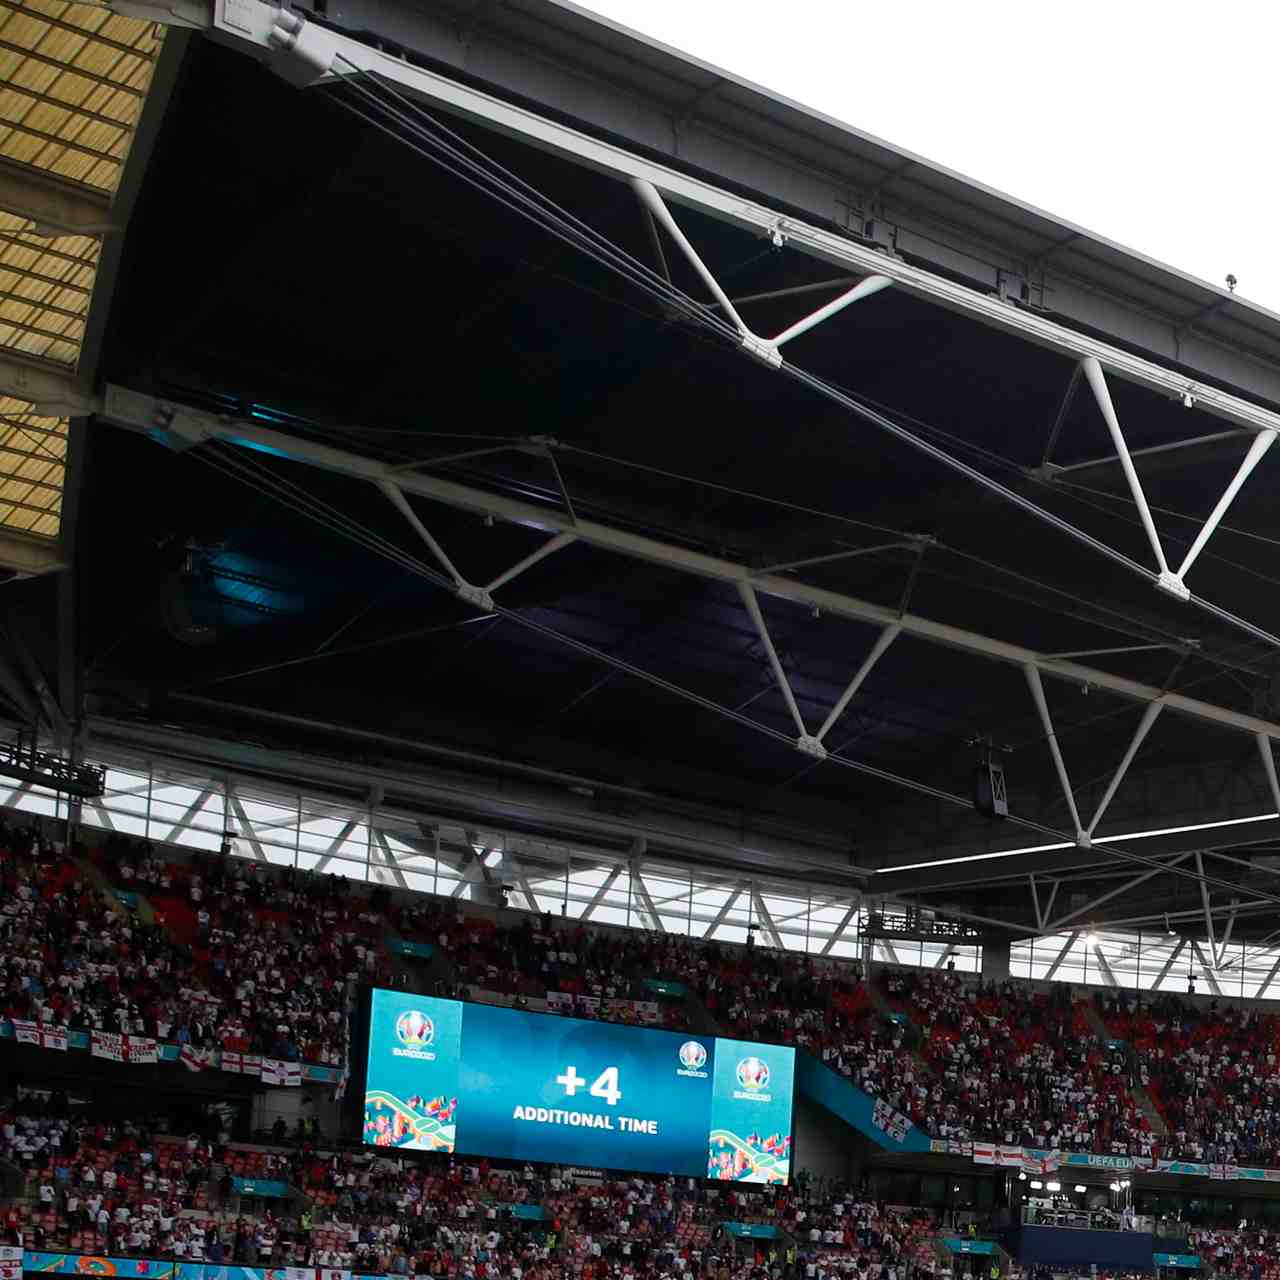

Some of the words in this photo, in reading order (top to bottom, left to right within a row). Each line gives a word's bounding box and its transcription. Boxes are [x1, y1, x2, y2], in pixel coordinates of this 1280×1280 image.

[556, 1066, 622, 1106] +4
[513, 1105, 614, 1130] ADDITIONAL
[618, 1116, 658, 1135] TIME
